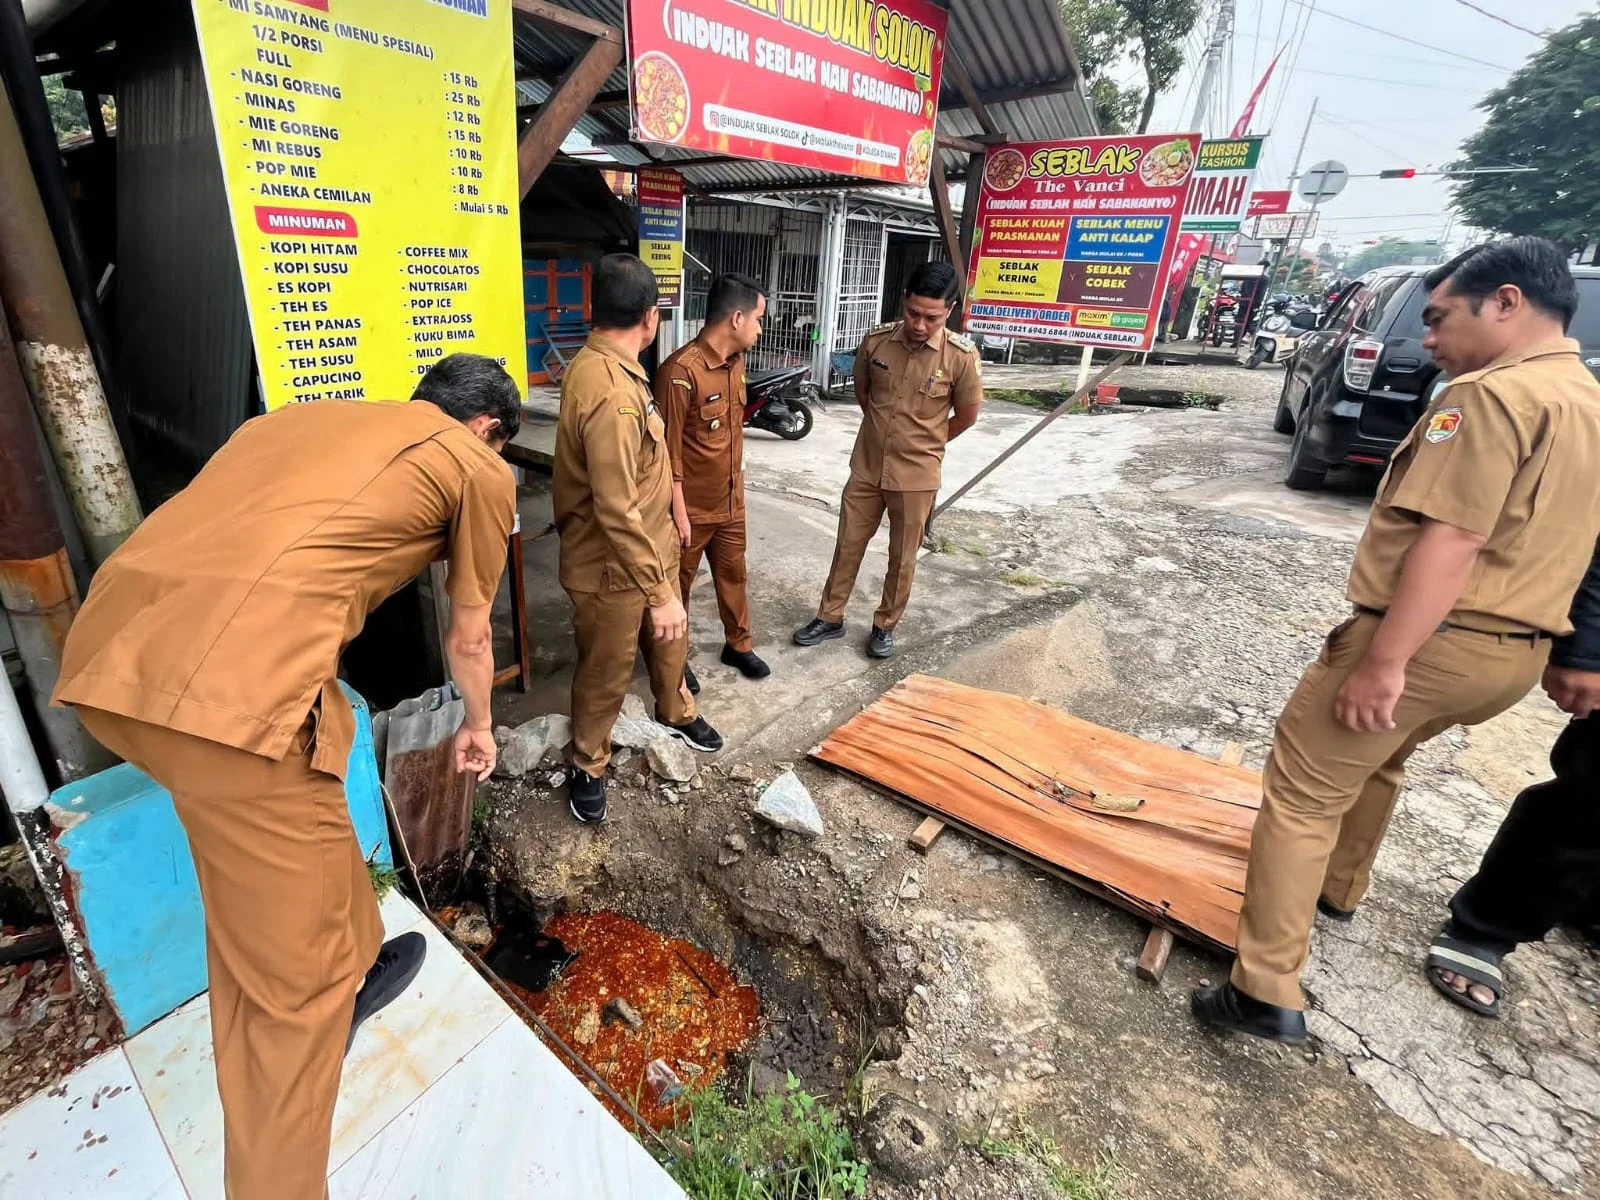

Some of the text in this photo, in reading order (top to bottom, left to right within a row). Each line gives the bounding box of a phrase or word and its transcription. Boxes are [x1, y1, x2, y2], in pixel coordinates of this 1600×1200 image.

[229, 0, 434, 60] MI SAMYANG (MENU SPESIAL)
[252, 25, 323, 52] 1/2 PORSI
[874, 6, 935, 78] SOLOK
[256, 48, 292, 68] FULL
[755, 37, 816, 83] SEBLAK
[241, 69, 341, 99] NASI GORENG
[464, 75, 478, 88] Rb
[245, 92, 296, 113] MINAS
[466, 93, 480, 107] Rb
[466, 113, 480, 126] Rb
[249, 116, 339, 140] MIE GORENG
[468, 131, 481, 144] Rb
[252, 138, 321, 158] MI REBUS
[1201, 142, 1249, 157] KURSUS
[469, 149, 482, 162] Rb
[1028, 146, 1140, 176] SEBLAK
[1200, 157, 1246, 168] FASHION
[256, 161, 316, 179] POP MIE
[469, 166, 482, 180] Rb
[466, 183, 478, 196] Rb
[1034, 178, 1125, 193] The Vanci
[260, 183, 371, 204] ANEKA CEMILAN
[460, 201, 509, 215] Mulai 5 Rb
[1030, 198, 1070, 209] SEBLAK
[269, 215, 346, 231] MINUMAN
[990, 219, 1065, 228] SEBLAK KUAH
[1076, 219, 1164, 229] SEBLAK MENU
[990, 232, 1060, 241] PRASMANAN
[1079, 233, 1154, 243] ANTI KALAP
[271, 241, 357, 256] KOPI HITAM
[405, 247, 468, 258] COFFEE MIX
[274, 262, 348, 274] KOPI SUSU
[407, 265, 480, 275] CHOCOLATOS
[999, 262, 1039, 271] SEBLAK
[1085, 265, 1132, 275] SEBLAK
[998, 274, 1037, 283] KERING
[1085, 278, 1127, 288] COBEK
[278, 281, 330, 294] ES KOPI
[409, 282, 467, 292] NUTRISARI
[280, 301, 327, 313] TEH ES
[411, 298, 451, 309] POP ICE
[412, 314, 472, 325] EXTRAJOSS
[971, 304, 1071, 321] BUKA DELIVERY ORDER
[1079, 311, 1145, 325] maxim gojek
[283, 318, 361, 333] TEH PANAS
[972, 321, 1003, 330] HUBUNGI
[1048, 328, 1067, 336] 6844
[1069, 331, 1103, 339] (INDUAK
[1103, 333, 1137, 342] SEBLAK)
[414, 329, 475, 342] KUKU BIMA
[286, 336, 357, 351] TEH ASAM
[416, 348, 443, 358] MILO
[289, 354, 354, 369] TEH SUSU
[292, 371, 362, 387] CAPUCINO
[295, 387, 365, 402] TEH TARIK
